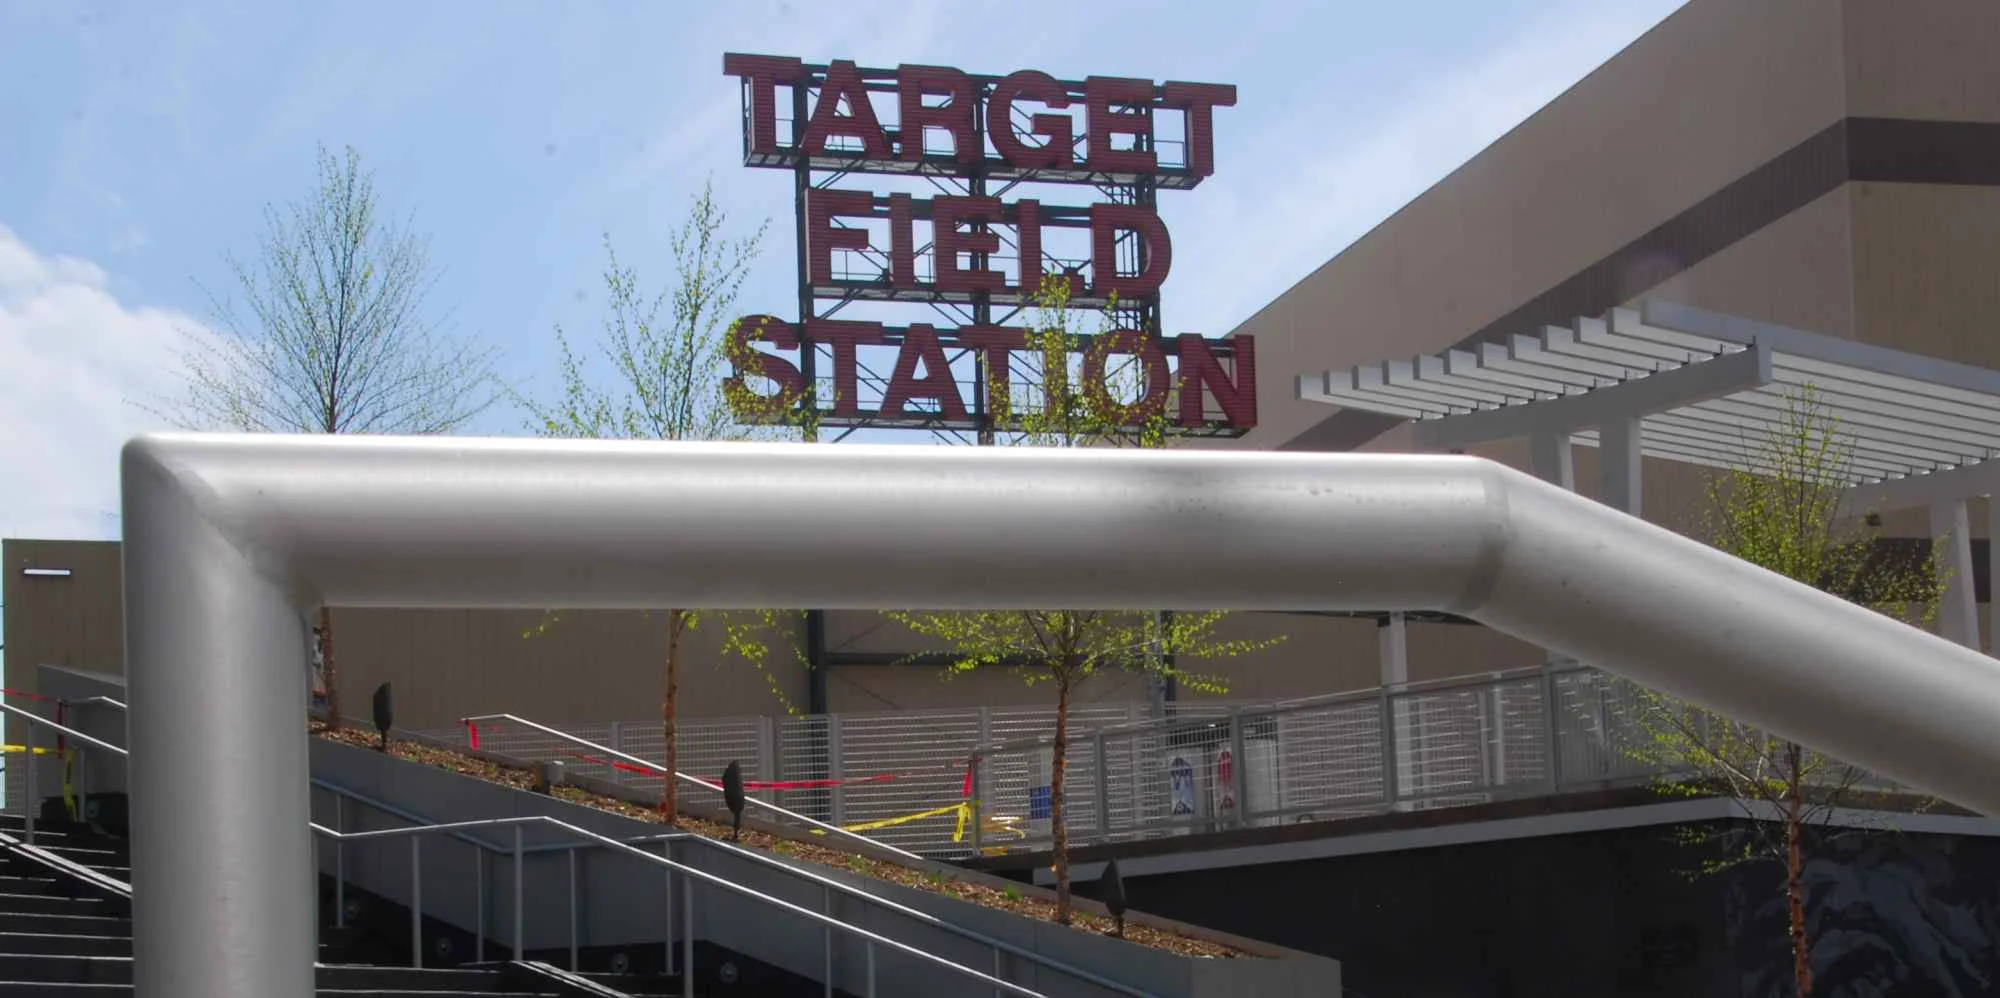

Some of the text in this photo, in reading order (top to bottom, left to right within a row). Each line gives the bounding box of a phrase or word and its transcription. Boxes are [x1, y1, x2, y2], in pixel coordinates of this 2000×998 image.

[724, 52, 1237, 177] TARGET
[805, 188, 1172, 297] FIELD
[723, 314, 1257, 429] STATION
